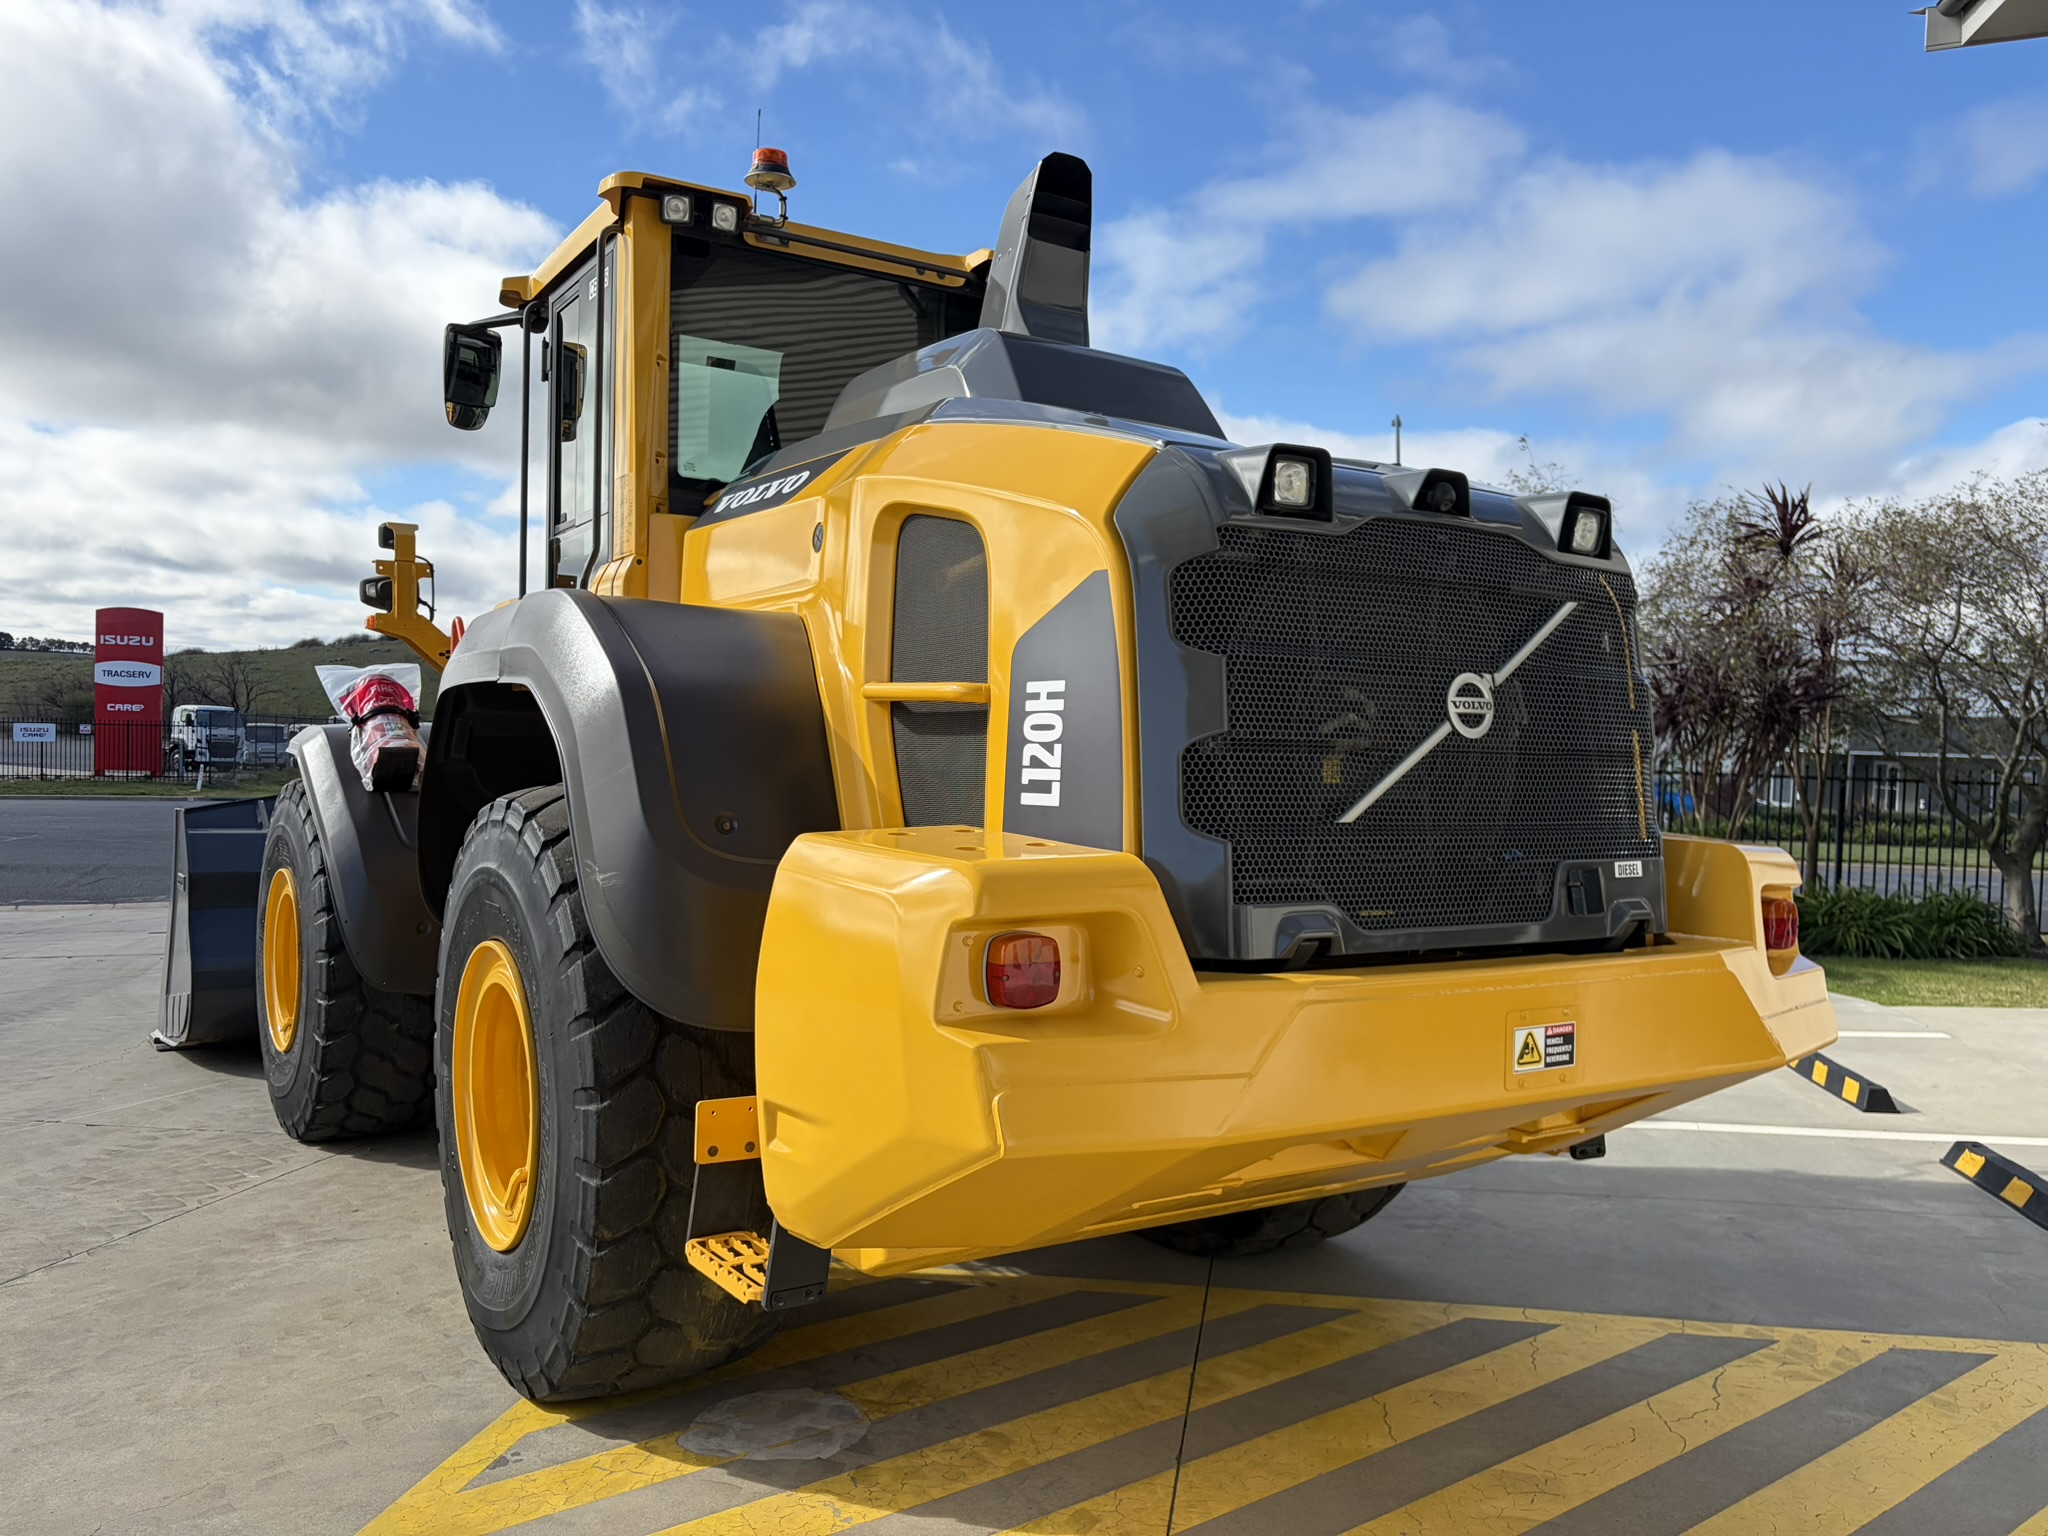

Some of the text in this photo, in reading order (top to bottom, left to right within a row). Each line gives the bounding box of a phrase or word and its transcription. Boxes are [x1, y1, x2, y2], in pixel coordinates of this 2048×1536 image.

[714, 470, 811, 514] VOLVO
[100, 634, 154, 646] ISUZU
[101, 669, 152, 679] TRACSERV
[107, 703, 144, 711] CARE
[1450, 700, 1493, 711] VOLVO
[1020, 680, 1066, 807] L120H
[1617, 863, 1639, 876] DIESEL
[1552, 1025, 1573, 1033] DANGER
[1546, 1036, 1564, 1045] VEHICLE
[1546, 1044, 1572, 1054] FREQUENTLY
[1546, 1054, 1570, 1063] REVERSING
